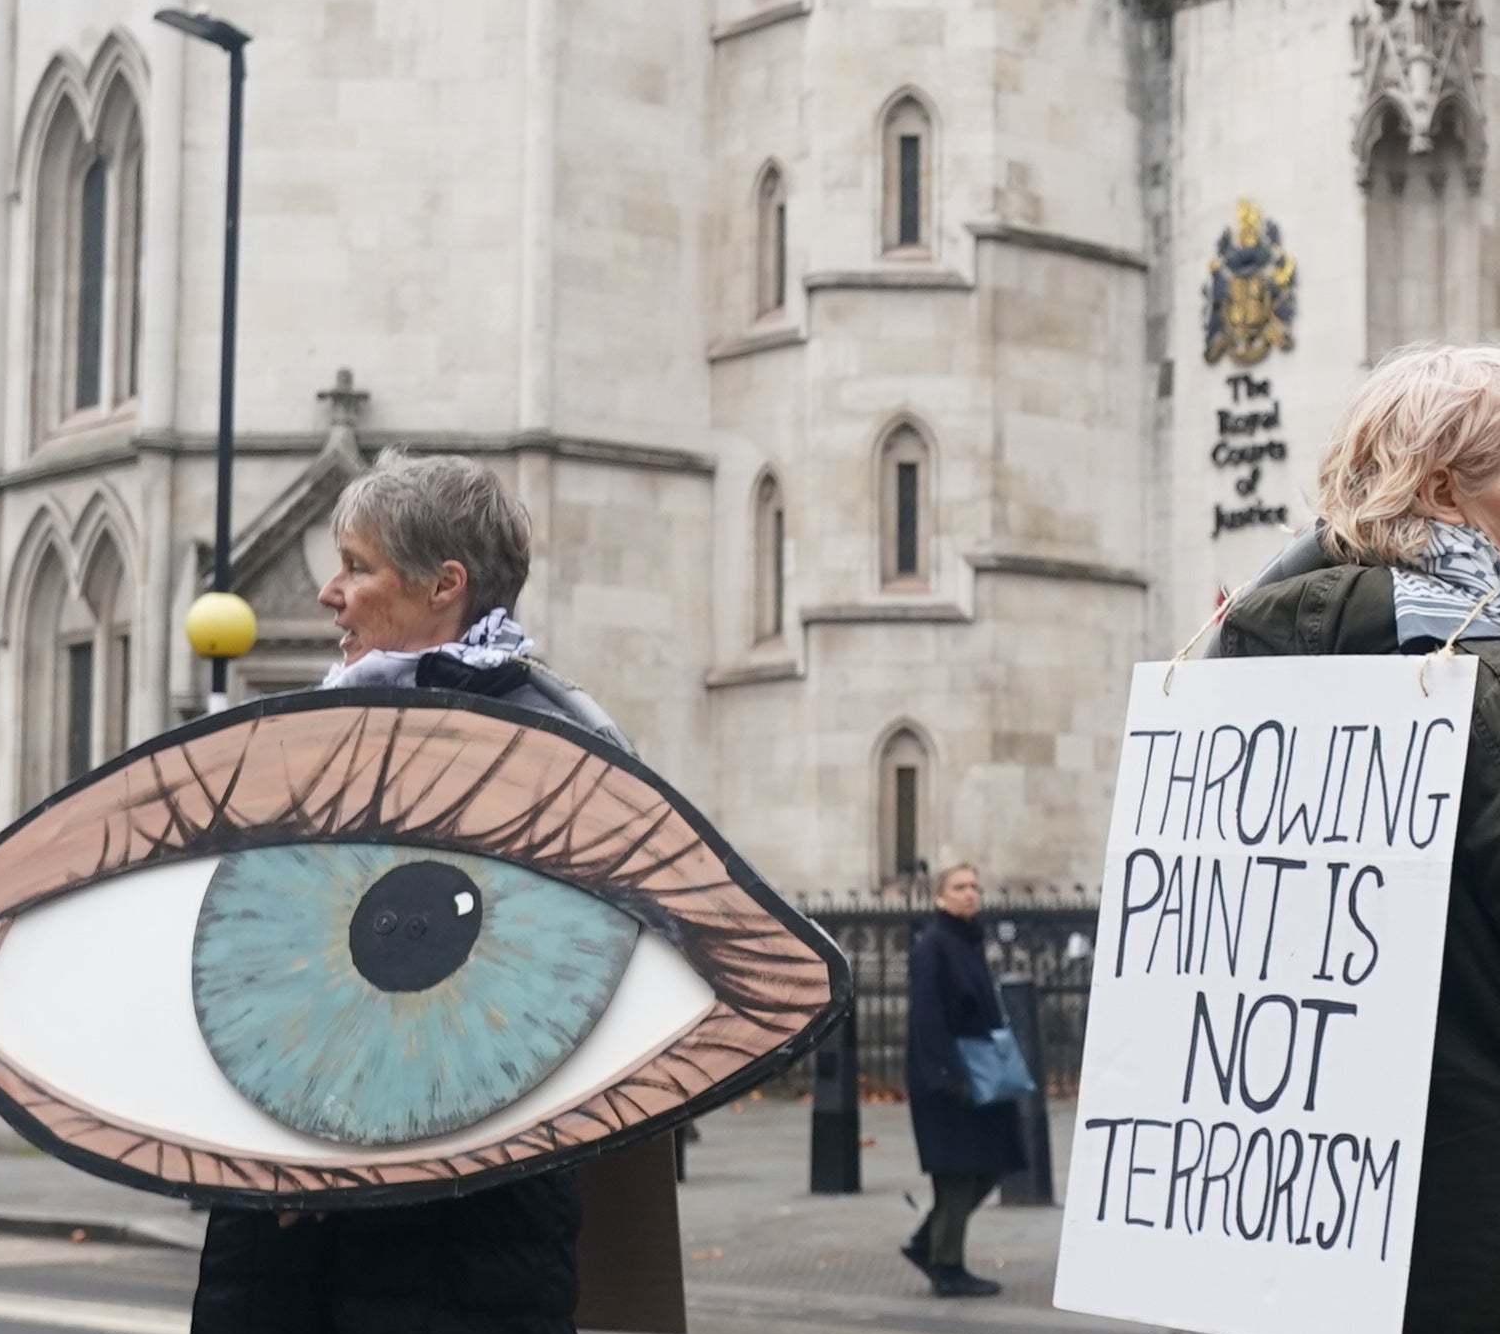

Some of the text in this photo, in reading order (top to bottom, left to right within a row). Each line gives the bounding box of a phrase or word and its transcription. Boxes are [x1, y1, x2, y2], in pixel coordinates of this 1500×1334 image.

[1226, 373, 1271, 403] The
[1212, 439, 1287, 467] Courts
[1211, 501, 1288, 539] Justice
[1130, 718, 1455, 849] THROWING
[1115, 848, 1385, 986] PAINT IS
[1181, 991, 1358, 1114] NOT
[1085, 1117, 1401, 1262] TERRORISM
